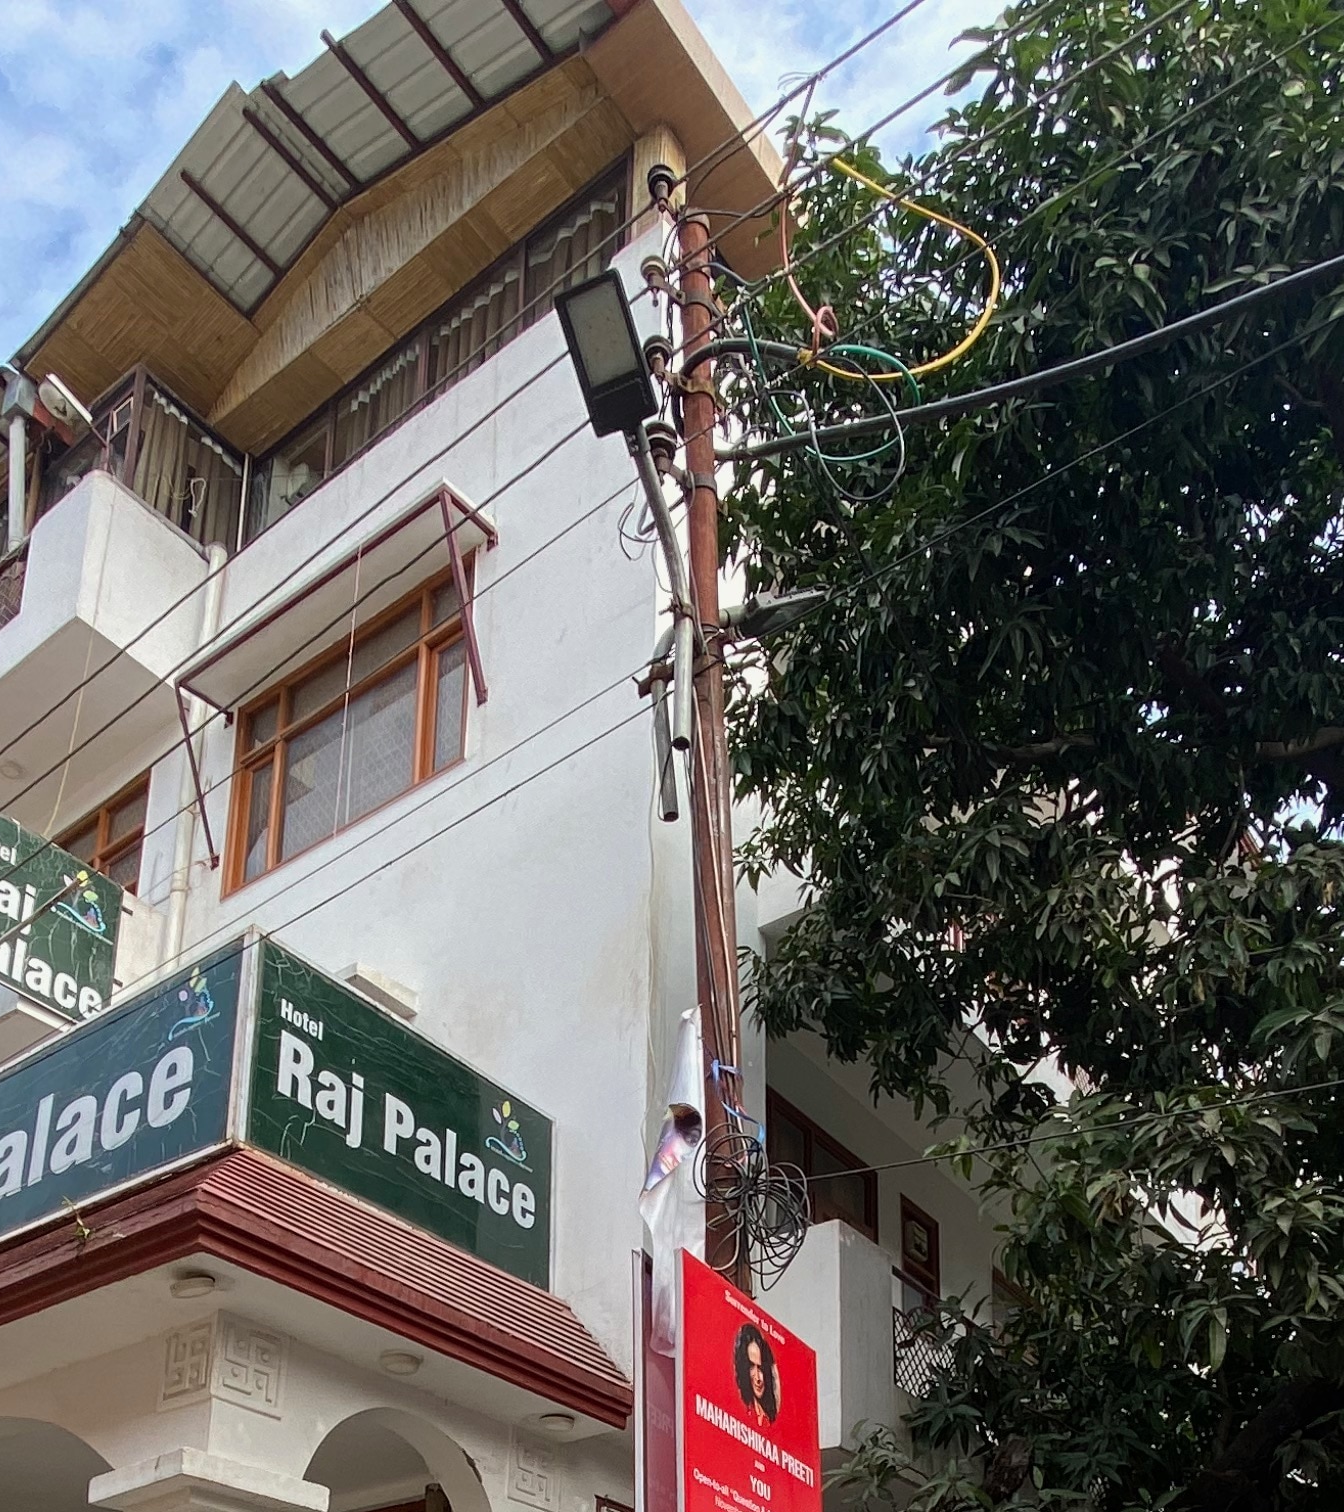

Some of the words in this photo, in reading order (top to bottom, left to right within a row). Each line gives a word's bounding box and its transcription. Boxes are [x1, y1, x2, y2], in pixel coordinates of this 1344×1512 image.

[280, 999, 325, 1042] Hotel
[276, 1028, 364, 1149] Raj
[383, 1091, 536, 1230] Palace
[696, 1393, 780, 1466] MAHARISHIKAA
[781, 1450, 814, 1488] PREETI
[749, 1474, 771, 1501] YOU
